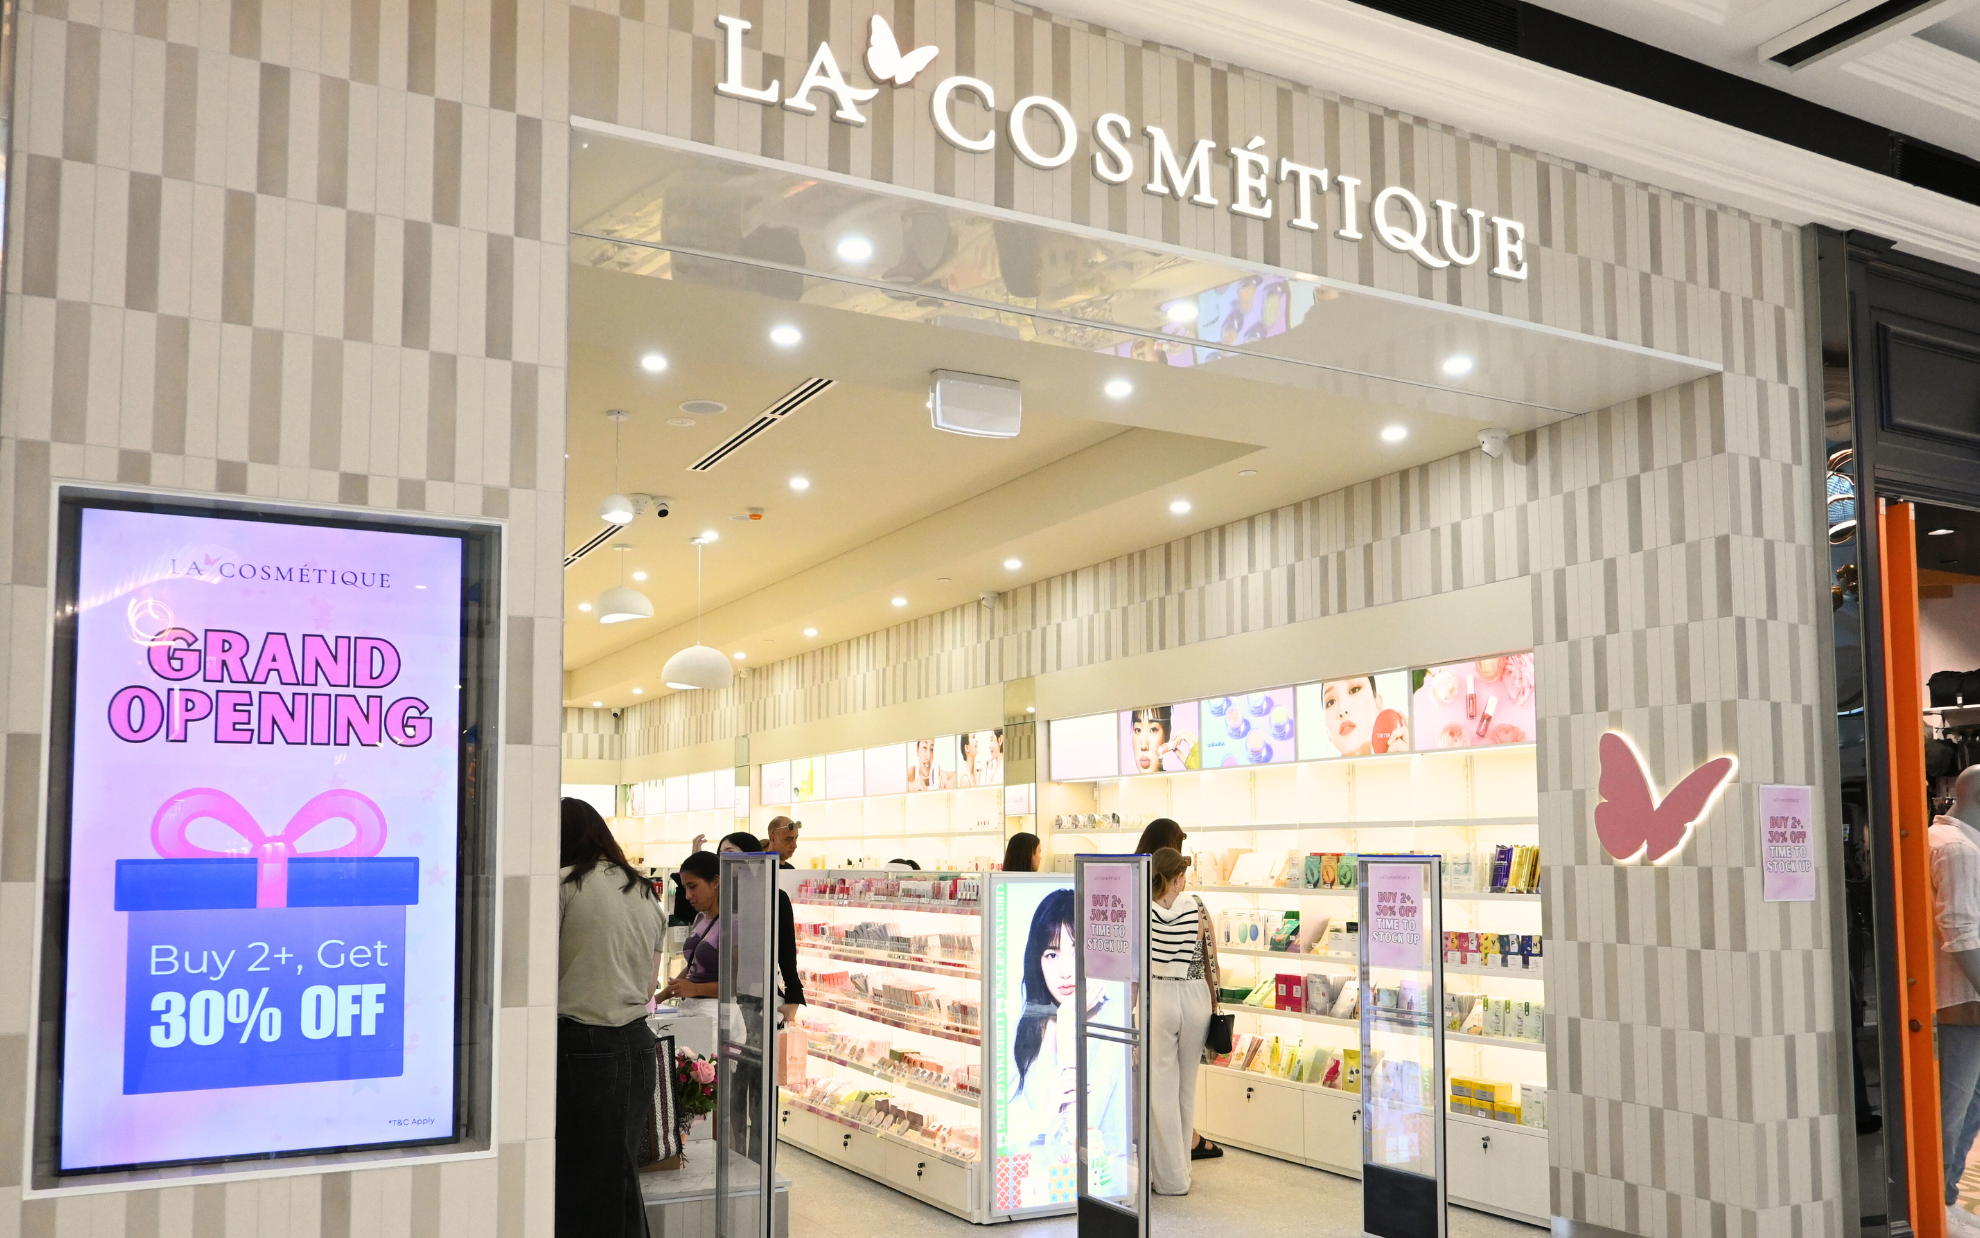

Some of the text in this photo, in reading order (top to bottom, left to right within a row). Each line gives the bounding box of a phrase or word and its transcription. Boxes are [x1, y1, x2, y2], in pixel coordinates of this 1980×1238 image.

[715, 14, 1528, 282] LA COSMÉTIQUE
[170, 558, 391, 588] LA COSMÉTIQUE
[147, 627, 401, 688] GRAND
[107, 685, 433, 747] OPENING
[1770, 816, 1804, 829] BUY 2+,
[1768, 830, 1807, 844] 30% OFF
[1769, 845, 1807, 858] TIME TO
[1766, 860, 1811, 873] STOCK UP
[1092, 894, 1124, 908] BUY 2+,
[1378, 891, 1414, 905] BUY 2+,
[1090, 908, 1127, 923] 30% OFF
[1375, 904, 1417, 918] 30% OFF
[1090, 923, 1125, 938] TIME TO
[1376, 918, 1416, 931] TIME TO
[996, 883, 1005, 995] CHRISTMAS GIFTING
[1087, 938, 1129, 953] STOCK UP
[1372, 931, 1420, 945] STOCK UP
[151, 939, 389, 981] Buy 2+, Get
[150, 983, 386, 1048] 30% OFF
[996, 1018, 1005, 1130] CHRISTMAS GIFTING
[411, 1117, 435, 1126] Apply
